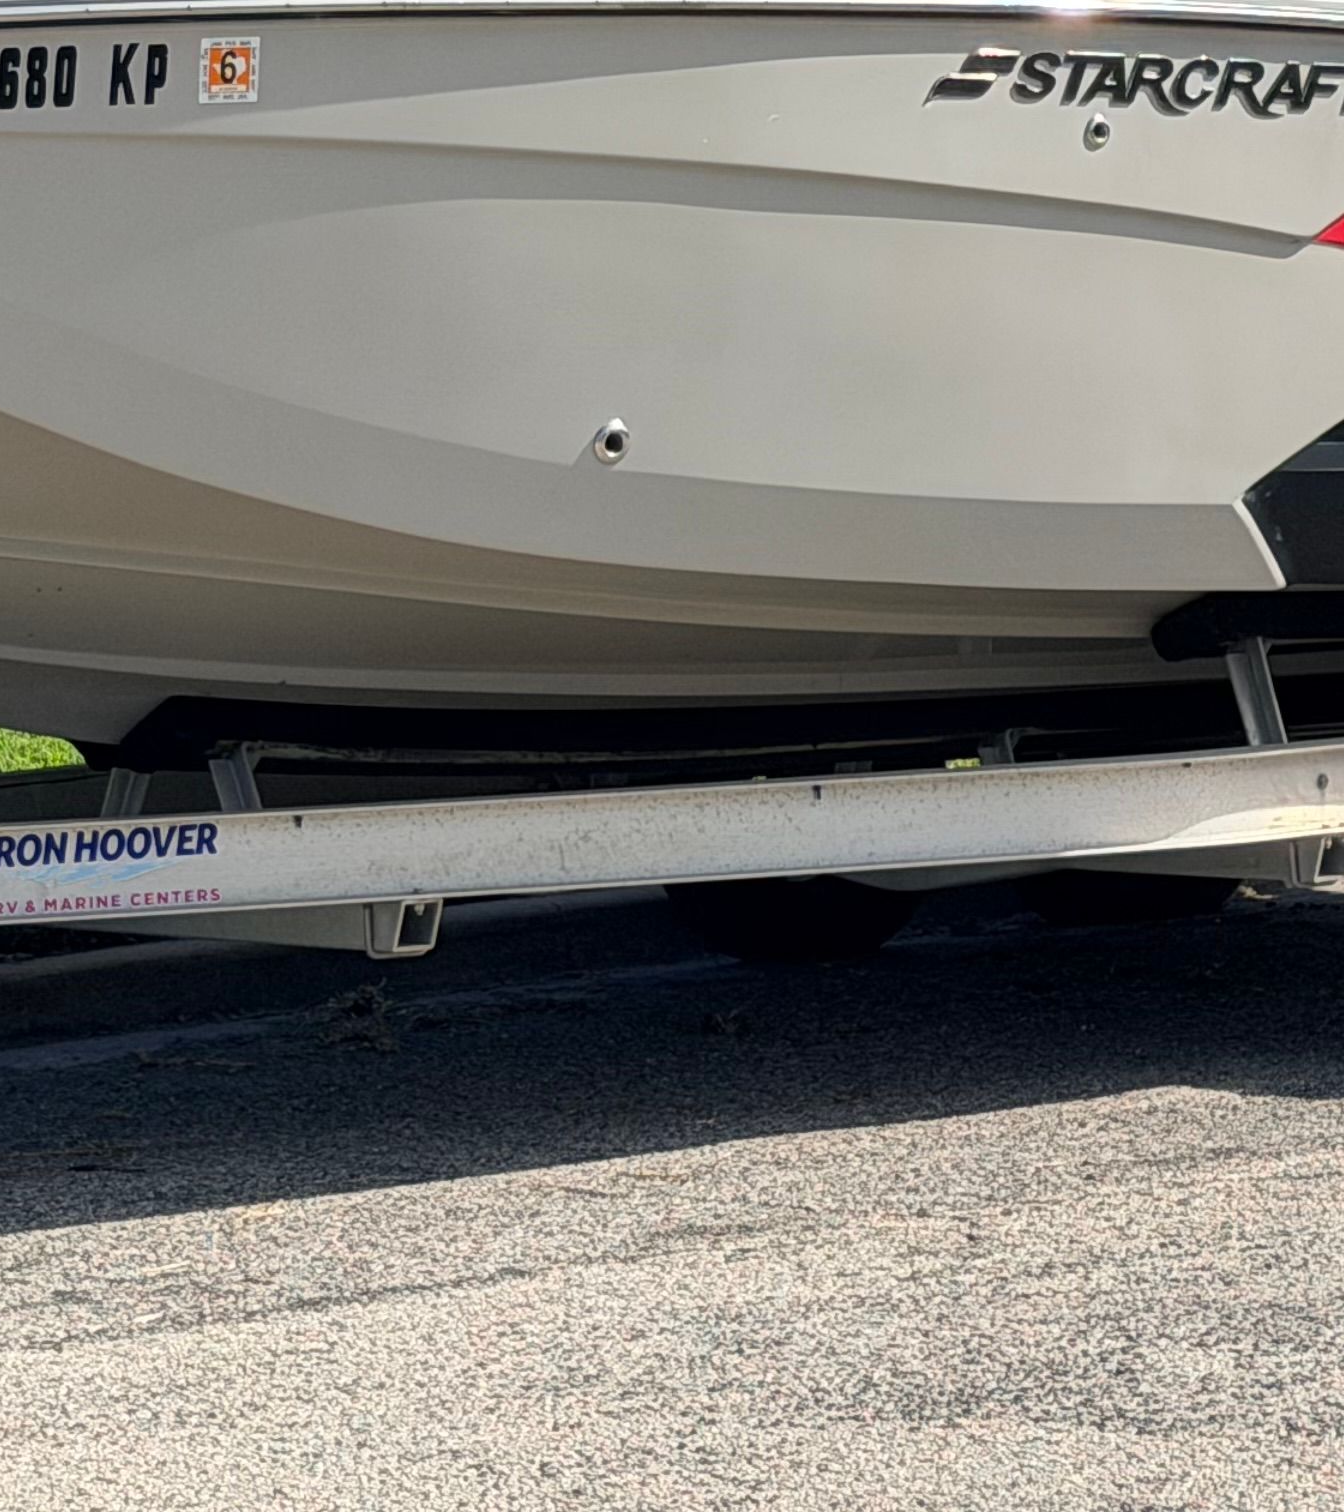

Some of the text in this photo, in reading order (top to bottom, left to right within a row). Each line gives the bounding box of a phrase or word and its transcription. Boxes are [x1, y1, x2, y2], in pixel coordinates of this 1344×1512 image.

[109, 43, 168, 106] KP
[220, 50, 237, 85] 6
[74, 823, 217, 863] HOOVER
[24, 899, 36, 914] &
[44, 893, 122, 912] MARINE
[130, 888, 222, 907] CENTERS
